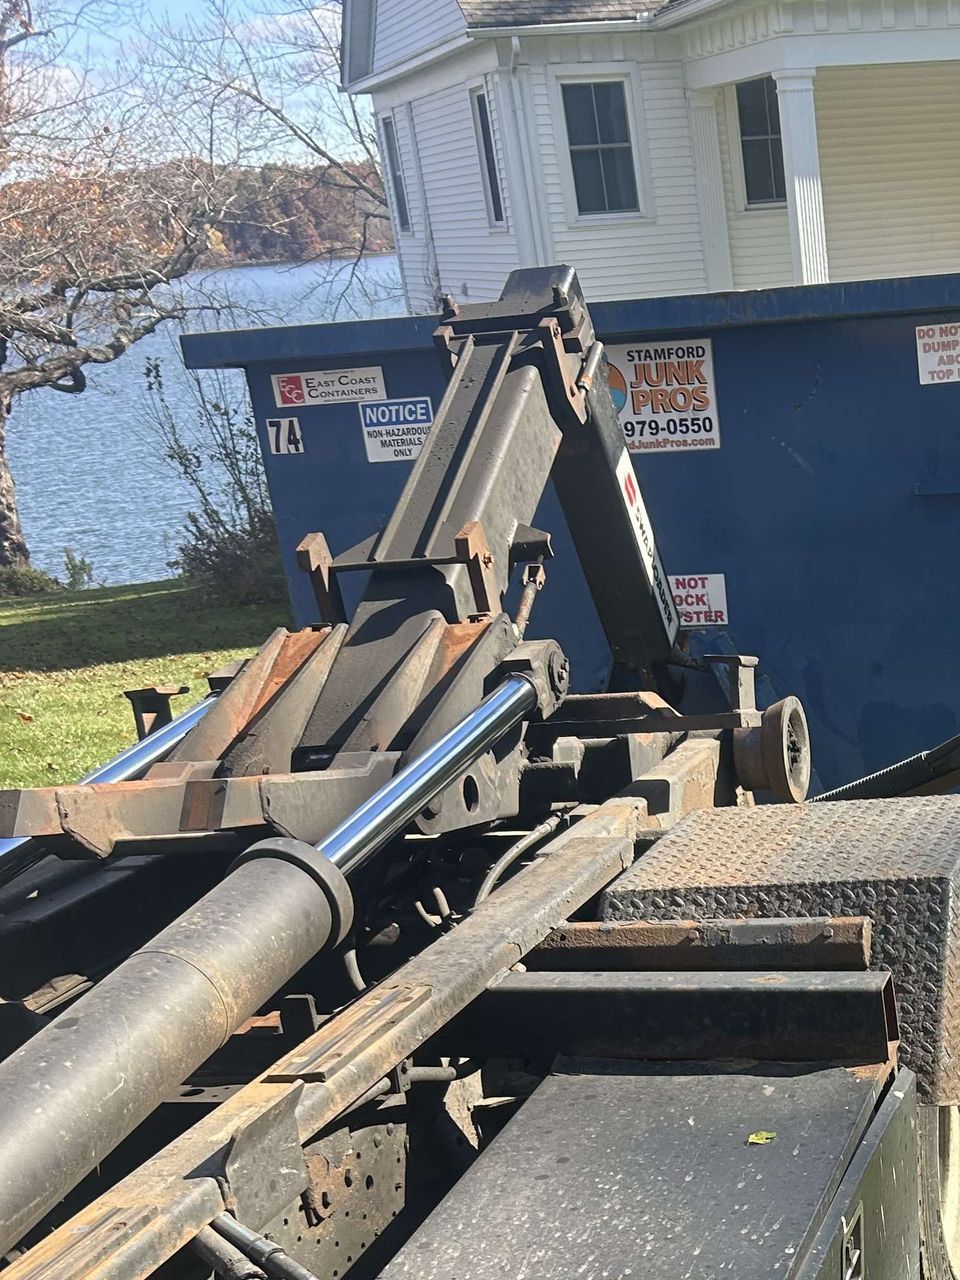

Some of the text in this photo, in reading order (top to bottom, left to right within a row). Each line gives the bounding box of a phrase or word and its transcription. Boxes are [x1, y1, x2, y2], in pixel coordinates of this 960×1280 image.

[917, 328, 936, 340] DO
[627, 346, 706, 362] STAMFORD
[630, 360, 708, 388] JUNK
[928, 368, 955, 381] TOP
[631, 385, 710, 416] PROS
[365, 403, 428, 424] NOTICE
[367, 426, 432, 439] NON-HAZARDOUS
[623, 416, 713, 438] 979-0550
[268, 419, 301, 454] 74
[381, 437, 423, 448] MATERIALS
[627, 437, 716, 450] dJunkPros.com
[393, 447, 413, 458] ONLY
[675, 577, 708, 589] NOT
[673, 594, 707, 606] OCK
